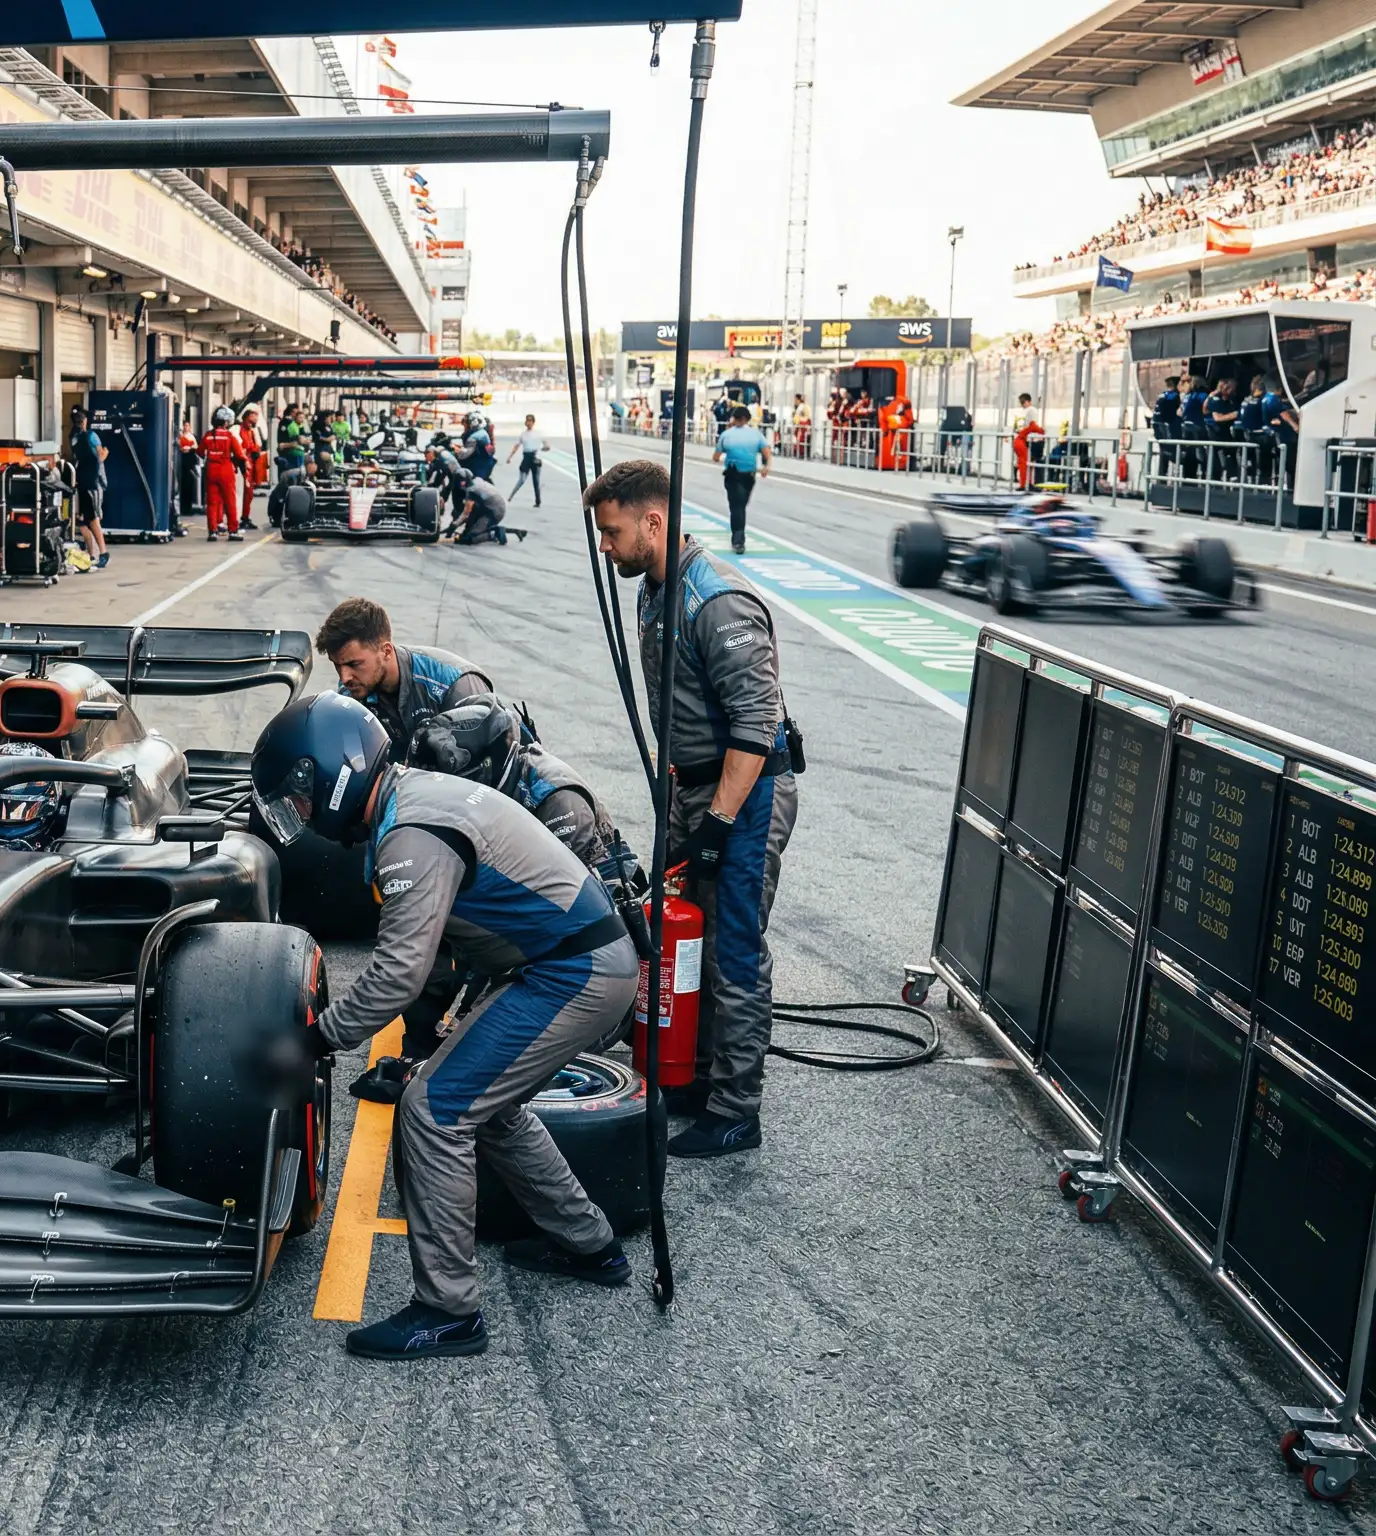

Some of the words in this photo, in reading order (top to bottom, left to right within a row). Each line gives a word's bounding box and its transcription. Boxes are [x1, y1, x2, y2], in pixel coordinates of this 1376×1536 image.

[898, 322, 932, 336] aws
[1290, 814, 1296, 829] 1
[1301, 818, 1321, 840] BOT
[1286, 838, 1293, 854] 2
[1298, 844, 1317, 865] ALB
[1282, 862, 1289, 878] 3
[1294, 868, 1314, 890] ALB
[1280, 887, 1286, 902] 4
[1292, 892, 1312, 914] DOT
[1276, 910, 1284, 926] 5
[1283, 964, 1301, 989] VER
